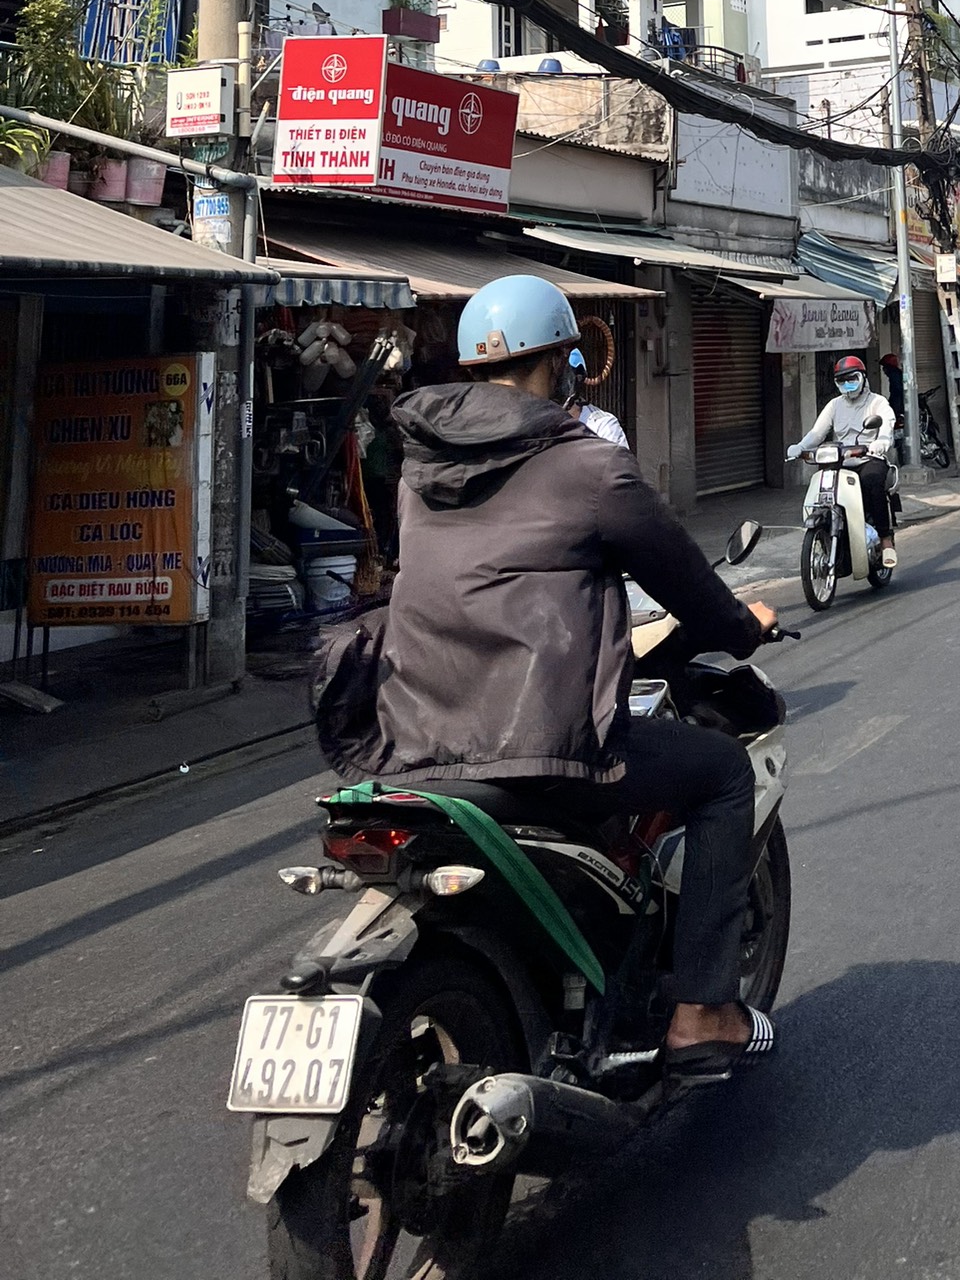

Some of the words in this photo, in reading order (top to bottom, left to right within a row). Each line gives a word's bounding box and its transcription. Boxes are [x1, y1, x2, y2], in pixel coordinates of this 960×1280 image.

[287, 85, 325, 103] điện
[328, 87, 374, 106] quang
[391, 95, 451, 136] quang
[289, 124, 321, 141] THIẾT
[325, 128, 336, 144] BỊ
[339, 125, 366, 144] ĐIỆN
[282, 145, 315, 168] TÍNH
[320, 145, 370, 168] THÀNH
[426, 140, 448, 153] QUANG
[165, 373, 187, 387] 66A
[108, 582, 131, 597] RAU
[577, 851, 621, 883] EXCITER
[239, 1057, 345, 1105] 492.07
